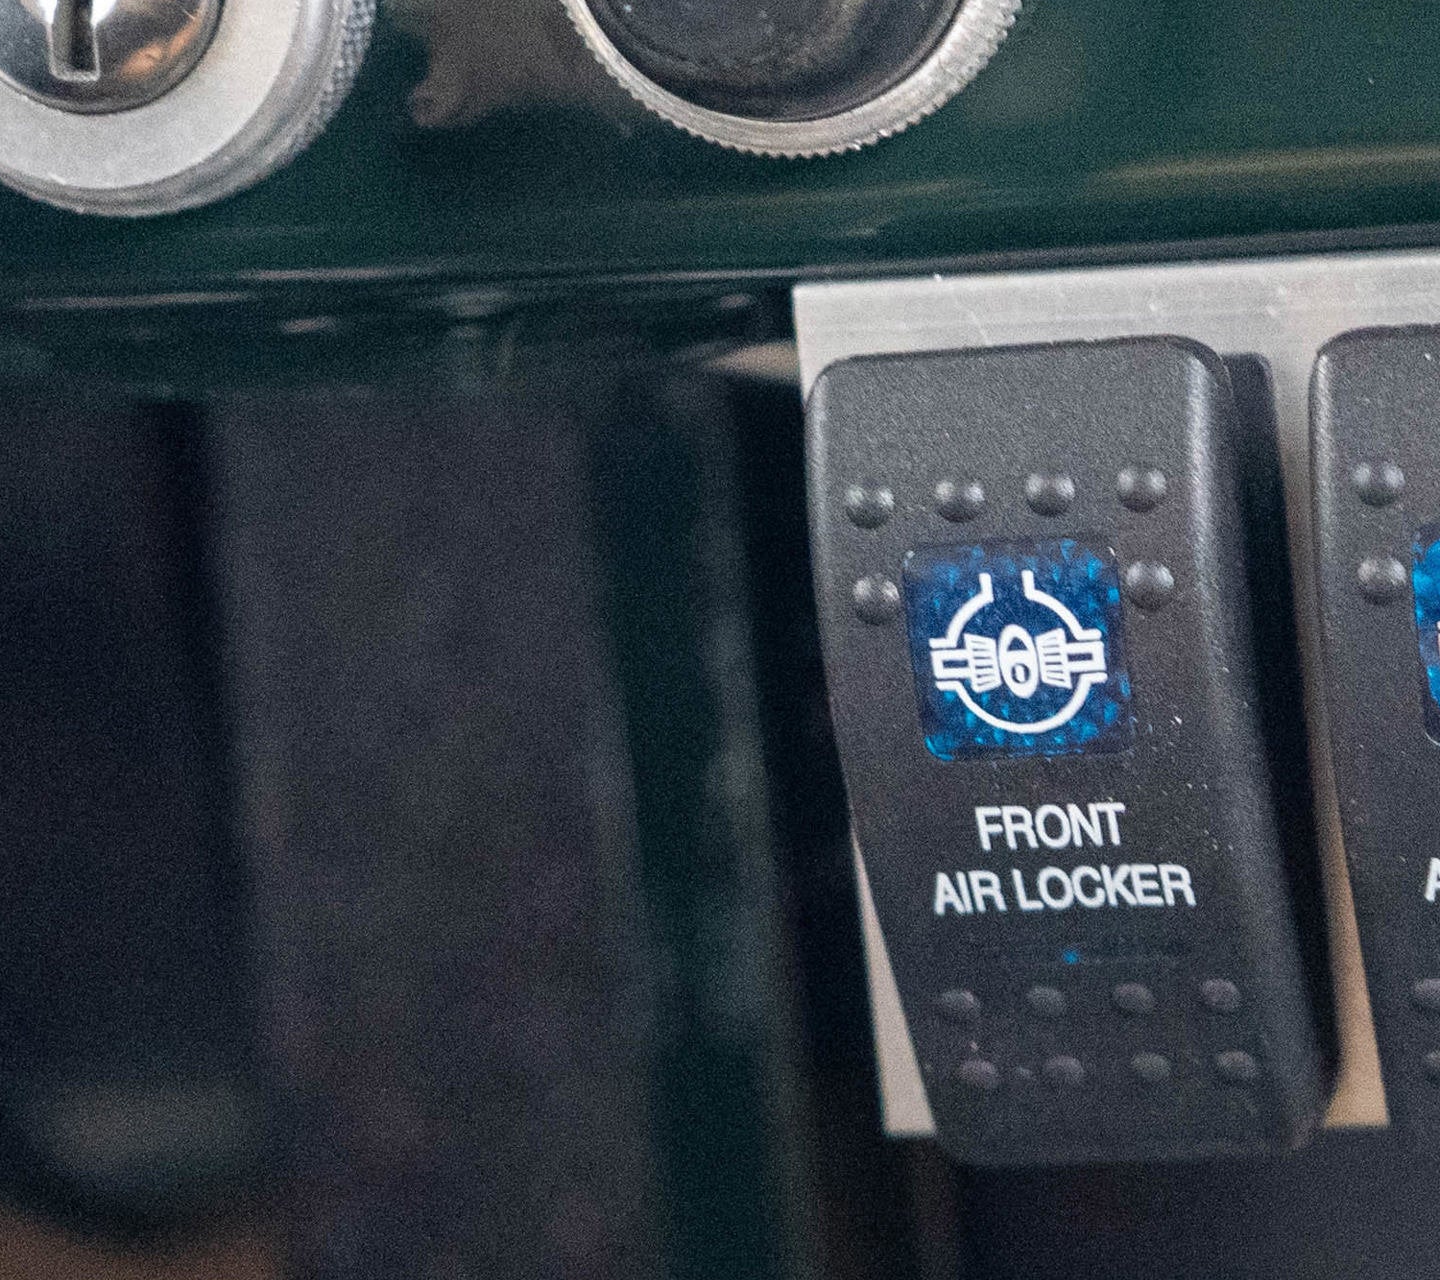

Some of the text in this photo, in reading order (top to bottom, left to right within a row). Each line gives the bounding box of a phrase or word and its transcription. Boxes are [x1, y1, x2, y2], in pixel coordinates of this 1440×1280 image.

[975, 801, 1126, 852] FRONT
[933, 862, 1197, 915] AIR LOCKER
